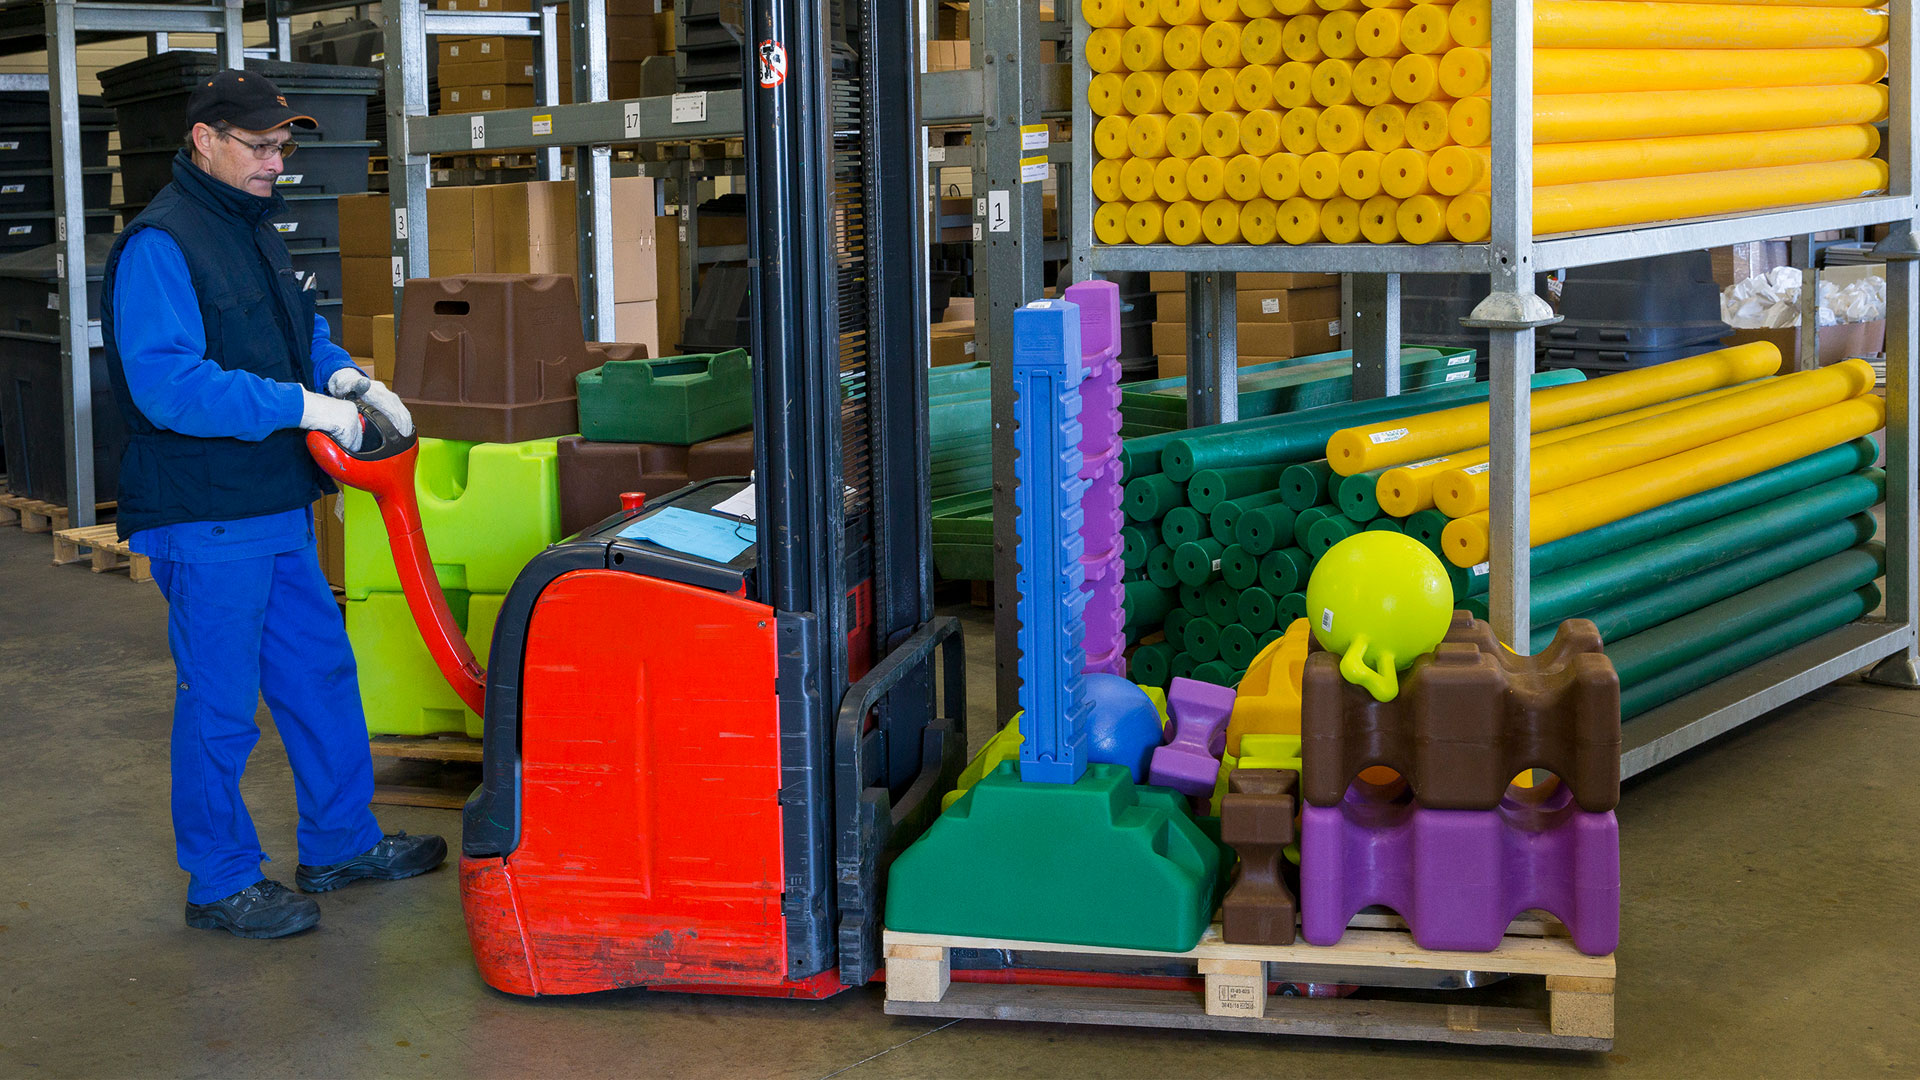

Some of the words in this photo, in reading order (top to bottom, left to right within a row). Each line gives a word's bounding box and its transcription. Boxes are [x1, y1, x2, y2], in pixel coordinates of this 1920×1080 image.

[626, 114, 638, 128] 17
[473, 126, 484, 139] 18
[979, 202, 984, 211] 6
[994, 202, 1004, 221] 1
[398, 215, 404, 230] 3
[975, 227, 980, 236] 7
[395, 264, 401, 278] 4
